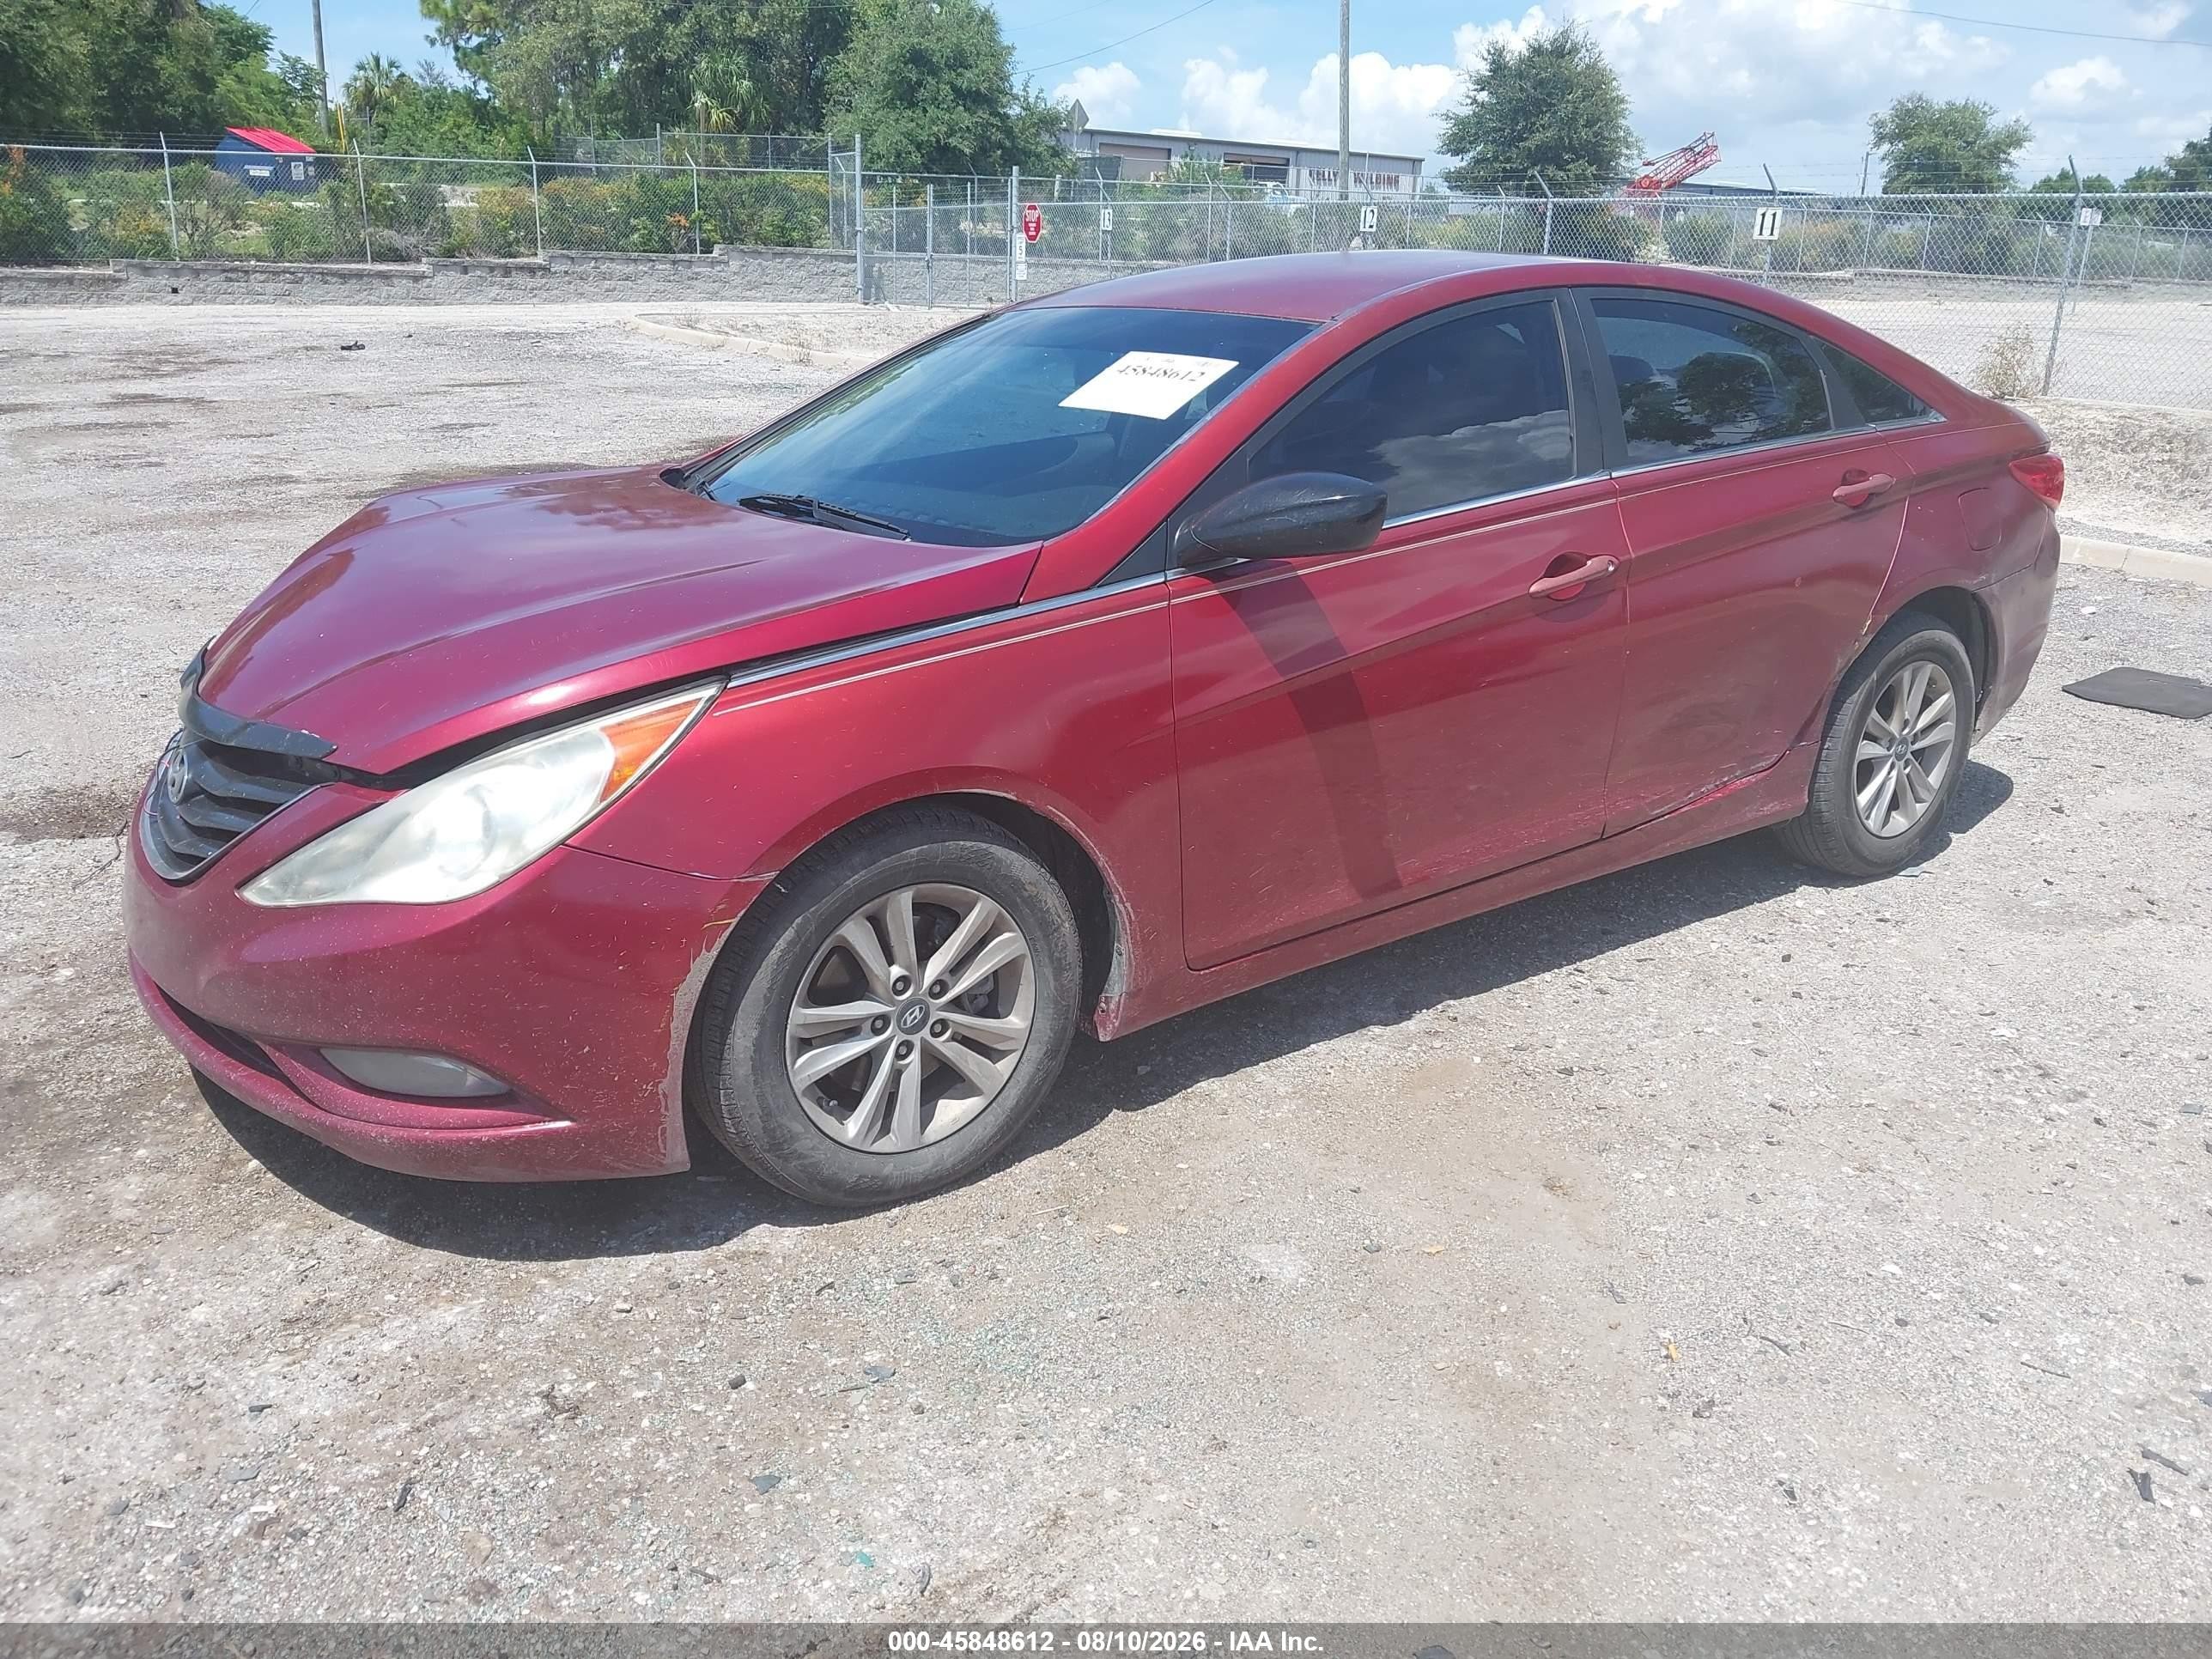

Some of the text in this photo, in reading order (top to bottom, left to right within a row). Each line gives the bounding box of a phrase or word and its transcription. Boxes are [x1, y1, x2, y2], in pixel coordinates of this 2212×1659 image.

[1025, 210, 1039, 222] STOP
[1103, 211, 1111, 228] 13
[1363, 209, 1376, 229] 12
[1757, 211, 1777, 236] 11
[1018, 246, 1024, 256] 5
